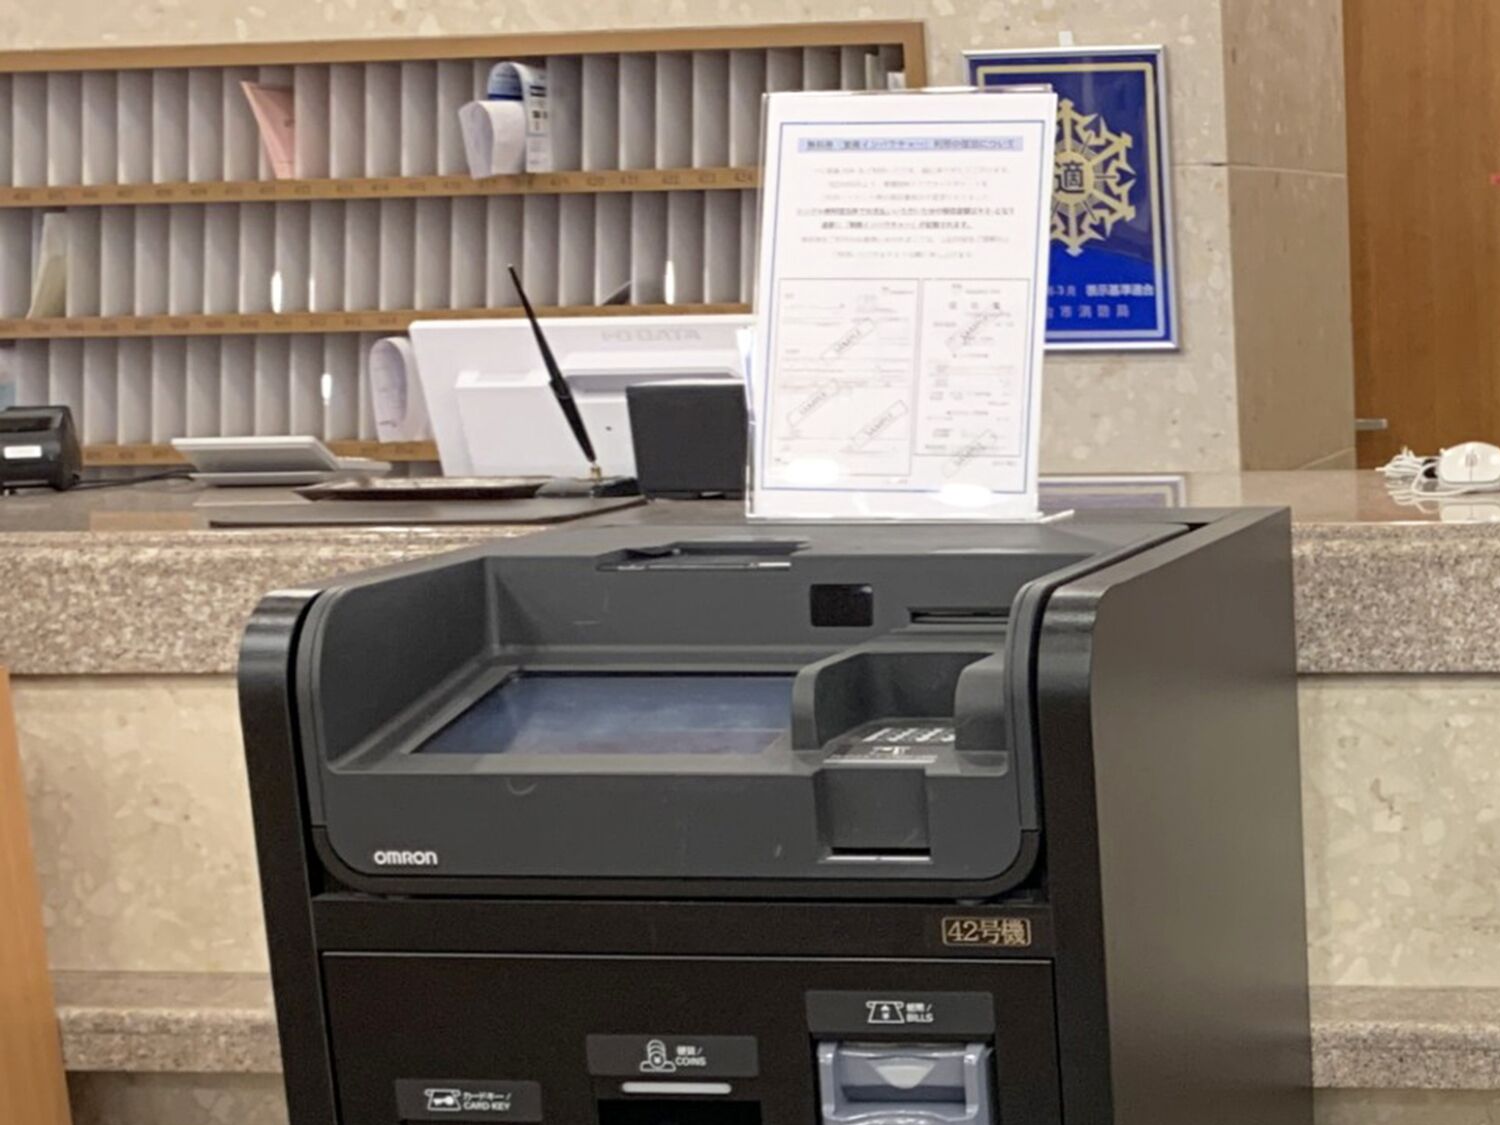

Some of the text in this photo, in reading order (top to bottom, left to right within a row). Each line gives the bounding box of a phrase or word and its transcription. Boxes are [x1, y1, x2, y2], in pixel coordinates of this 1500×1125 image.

[1054, 160, 1085, 194] 適
[374, 850, 438, 865] OMRON
[947, 918, 1026, 945] 42号機
[675, 1056, 706, 1066] COINS
[463, 1101, 511, 1111] CARD KEY
